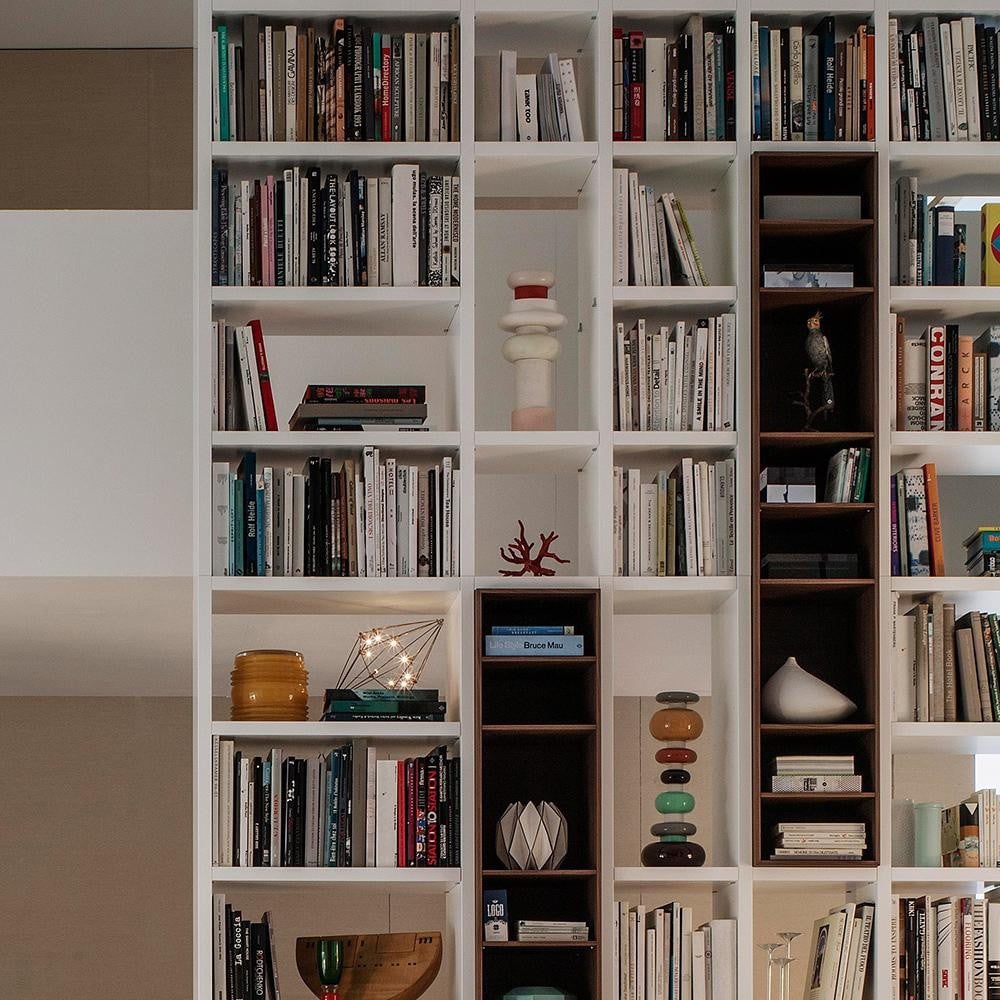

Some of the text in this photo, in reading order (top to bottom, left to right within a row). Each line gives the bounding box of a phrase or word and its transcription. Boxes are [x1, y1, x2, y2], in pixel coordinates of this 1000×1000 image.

[287, 48, 295, 78] GAVINA
[382, 54, 390, 106] HomeDirectory
[826, 57, 834, 93] Rolf Heide
[652, 369, 661, 389] Detail
[931, 327, 944, 431] CONRAN
[247, 501, 255, 537] Rolf Heide
[932, 502, 940, 525] BARKER
[234, 917, 242, 965] La Goccia
[256, 950, 264, 995] RODTCHENKO
